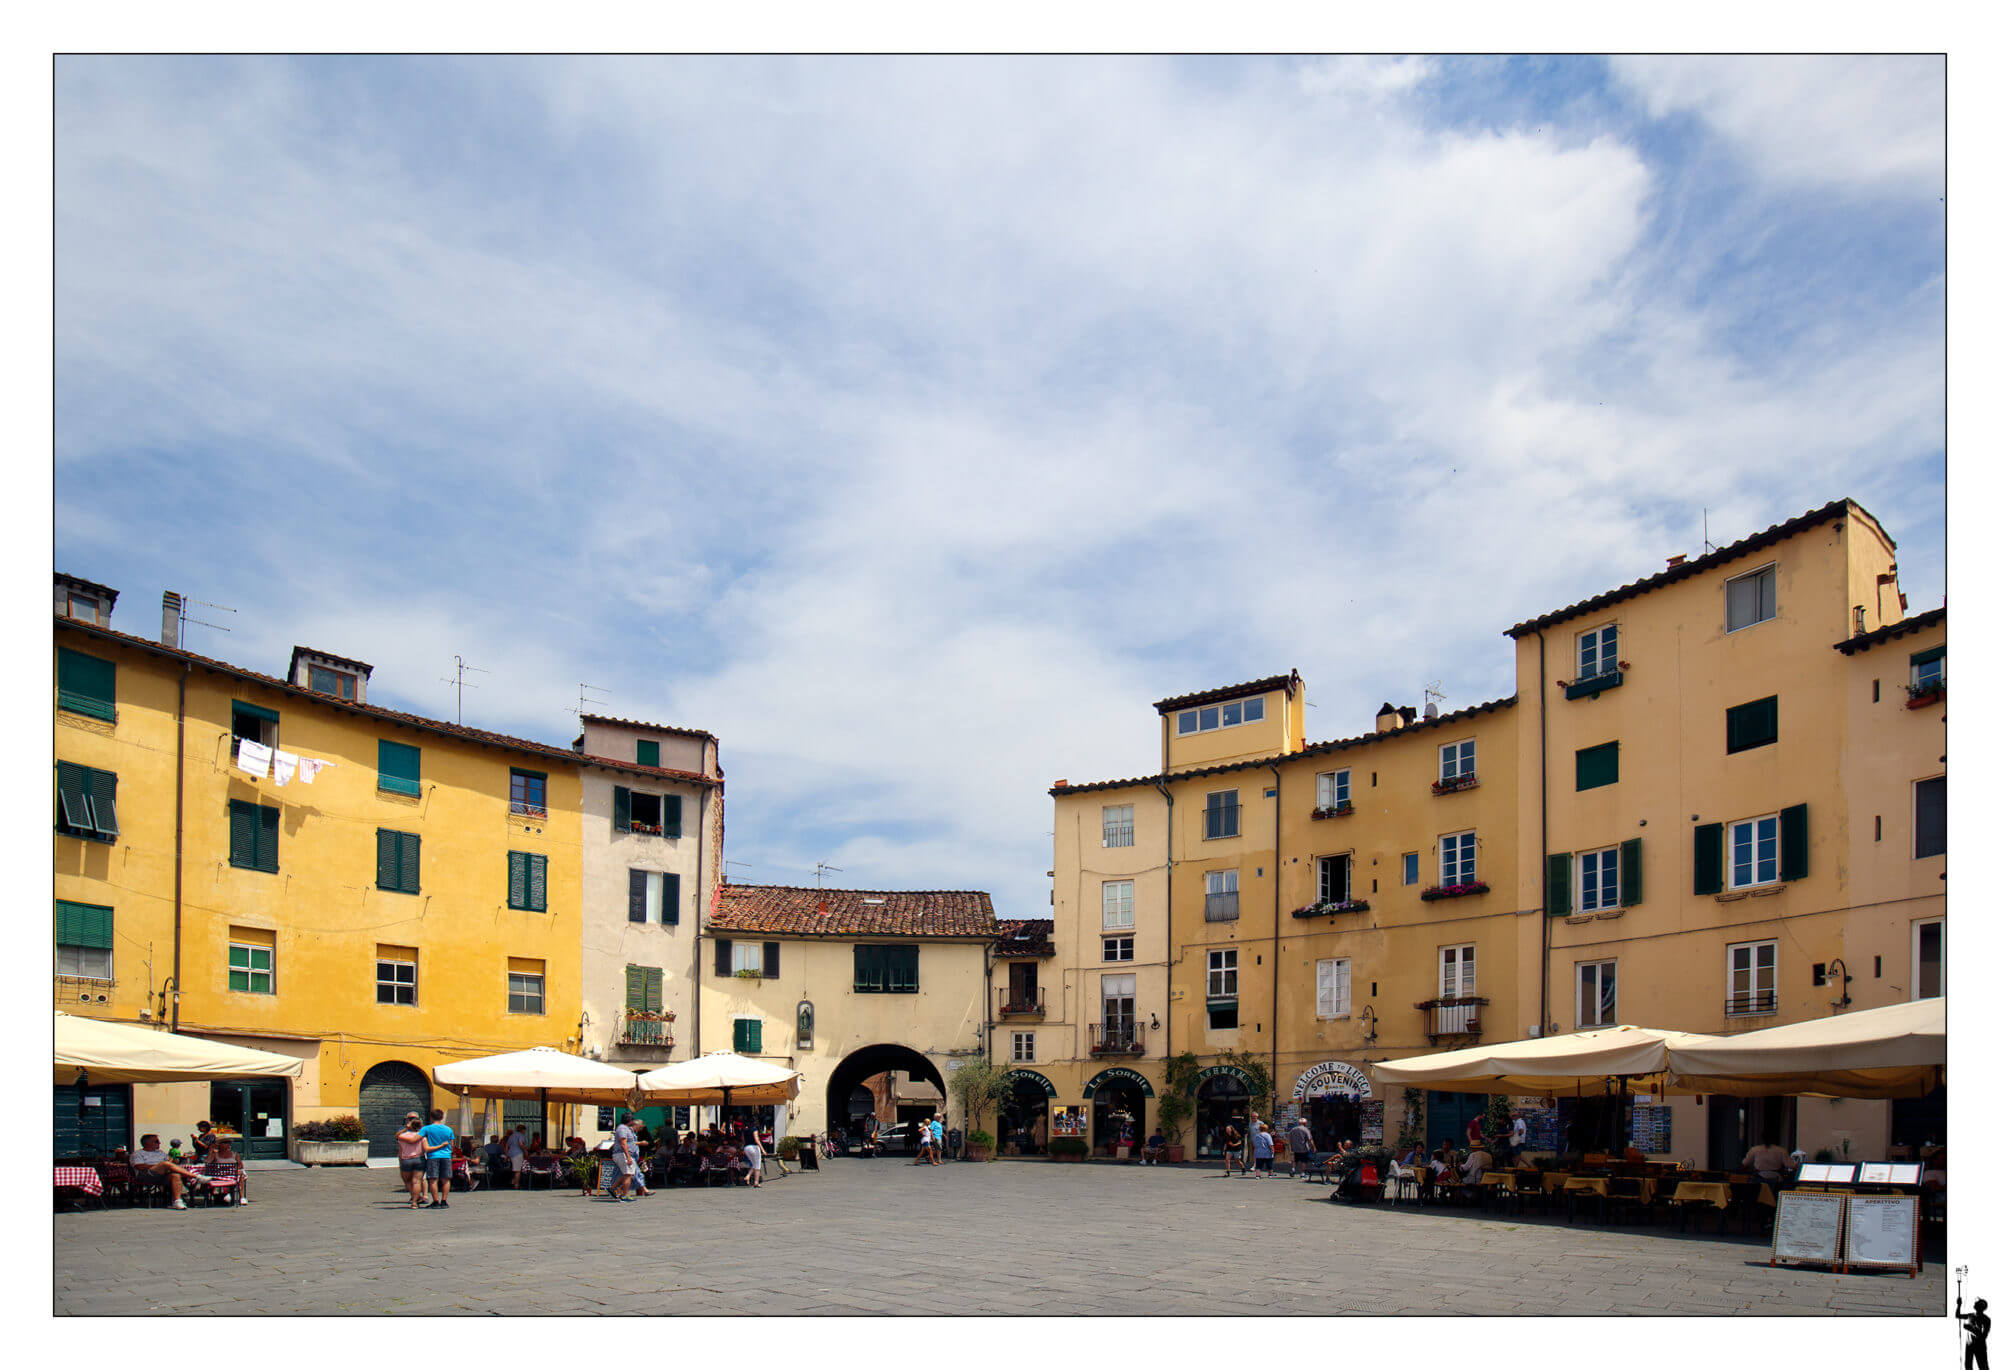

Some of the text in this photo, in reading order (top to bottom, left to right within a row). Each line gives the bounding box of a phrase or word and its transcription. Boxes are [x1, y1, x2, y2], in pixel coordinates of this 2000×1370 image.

[1293, 1062, 1335, 1097] WELCOME
[1346, 1065, 1371, 1096] LUCCA
[1311, 1075, 1359, 1092] SOUVENIR
